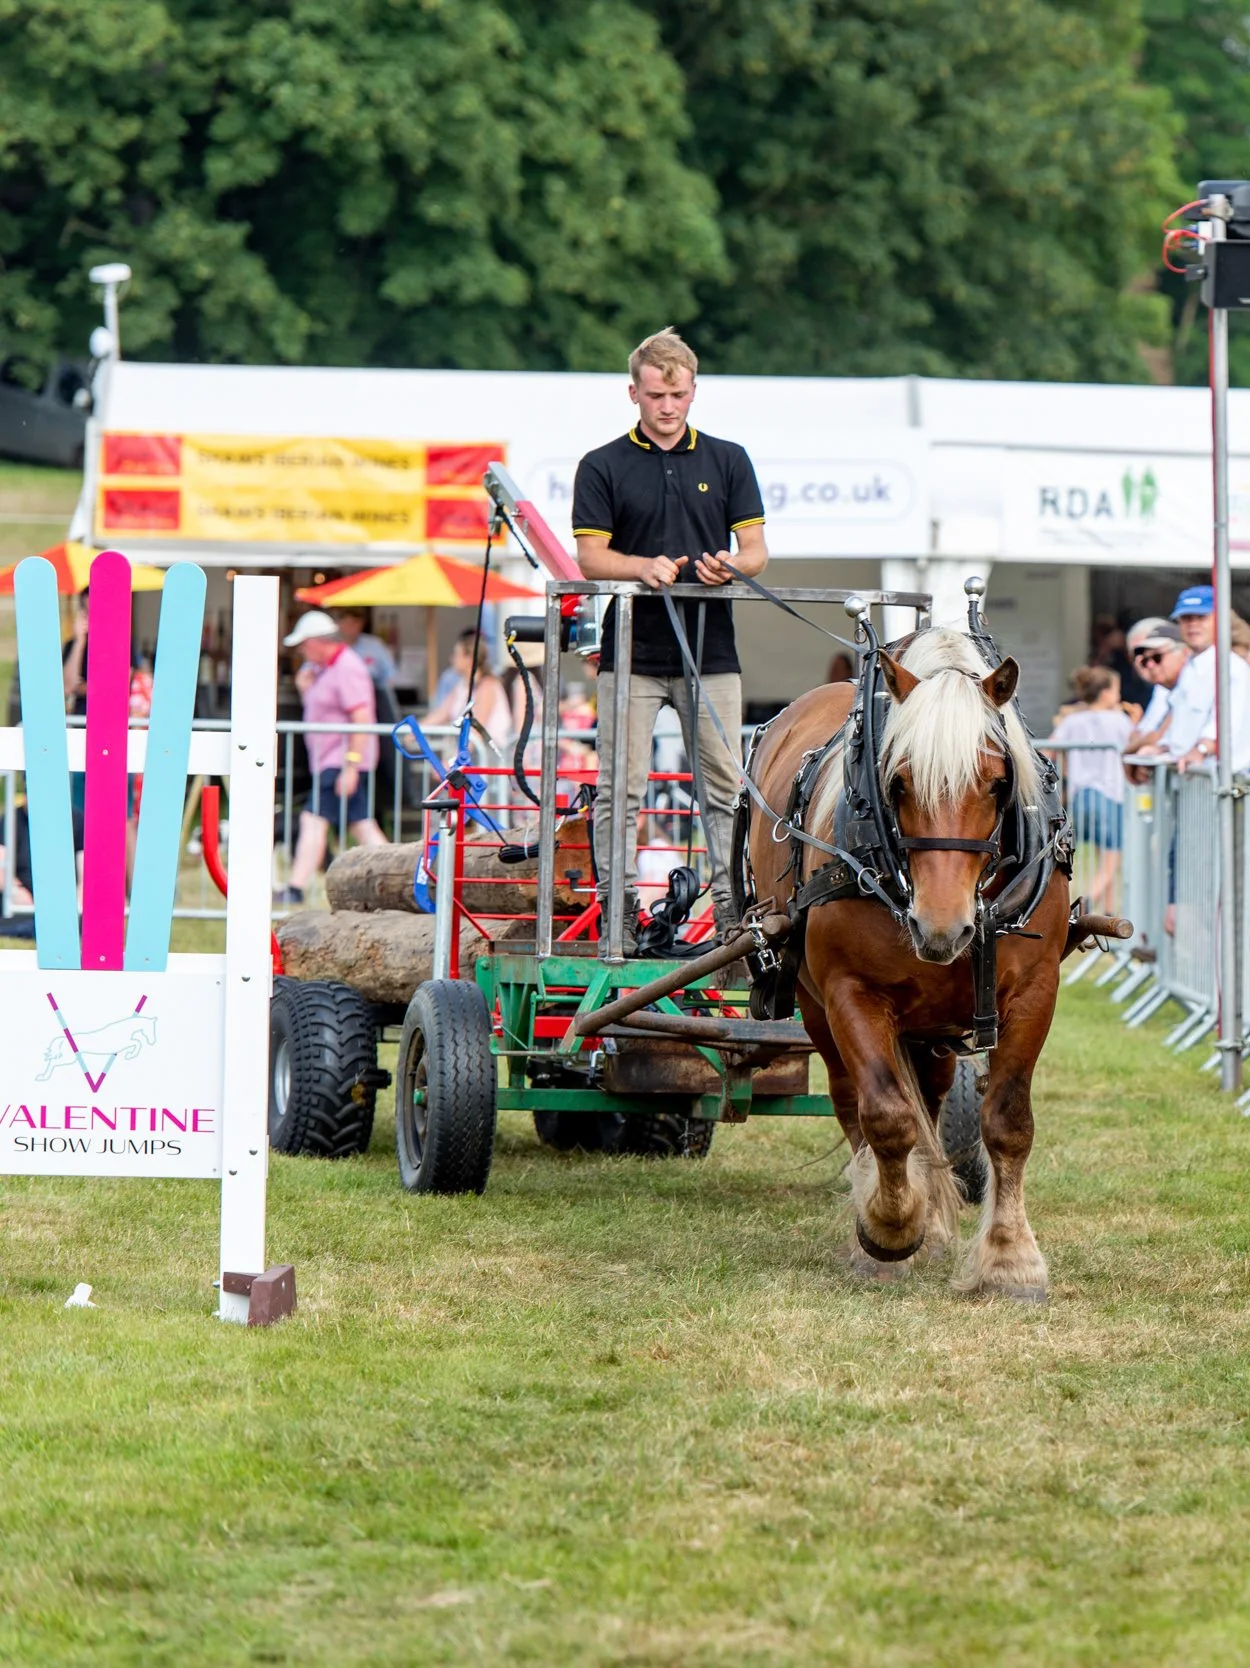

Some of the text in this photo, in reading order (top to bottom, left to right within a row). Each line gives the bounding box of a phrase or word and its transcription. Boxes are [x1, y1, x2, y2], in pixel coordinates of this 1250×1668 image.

[1038, 486, 1114, 520] RDA
[14, 1136, 183, 1156] SHOW JUMPS
